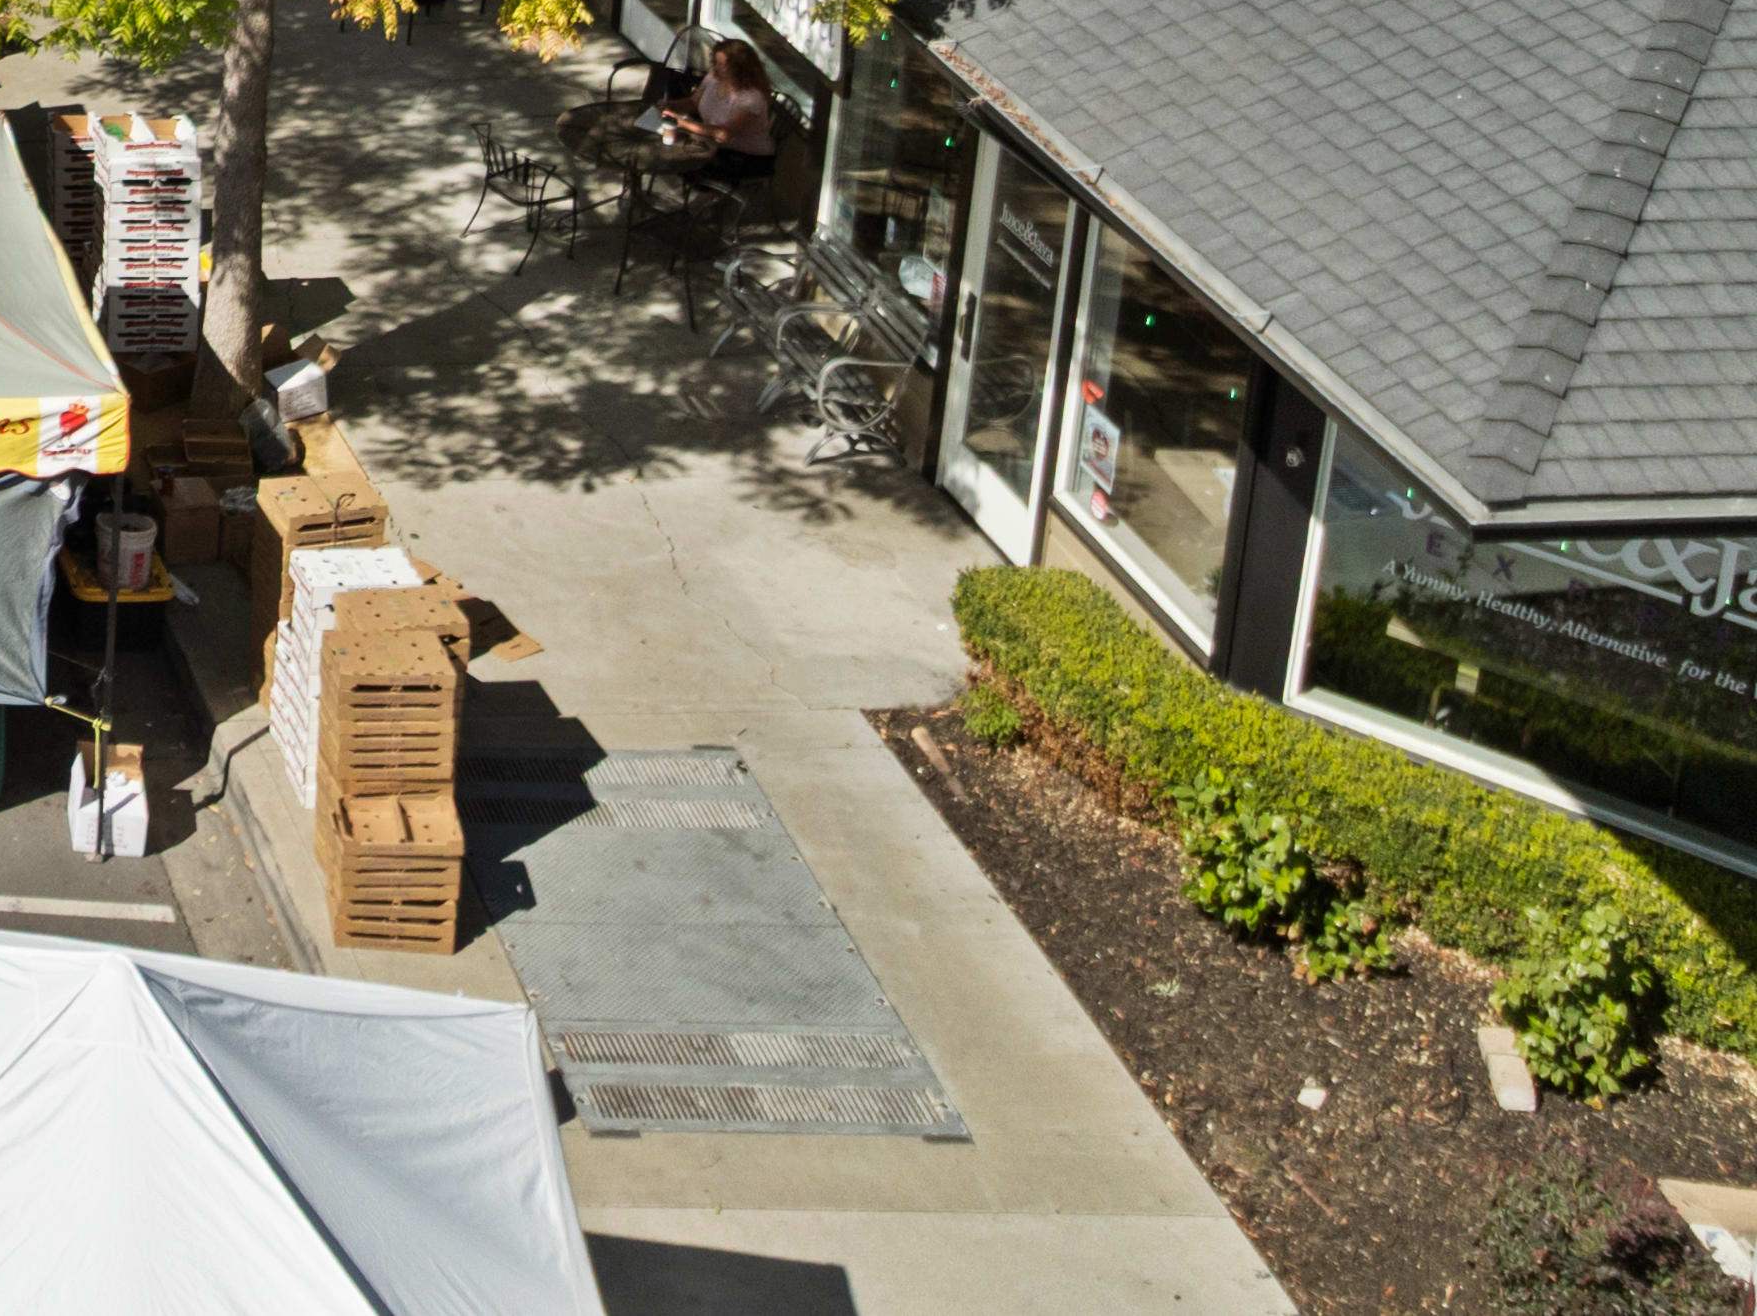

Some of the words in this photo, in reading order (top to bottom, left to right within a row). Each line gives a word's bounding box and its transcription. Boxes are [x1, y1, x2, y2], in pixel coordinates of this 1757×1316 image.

[1383, 559, 1395, 575] A
[1403, 564, 1471, 602] Yummy,
[1559, 620, 1669, 667] Alternative
[1677, 659, 1711, 681] for
[1715, 670, 1747, 695] the
